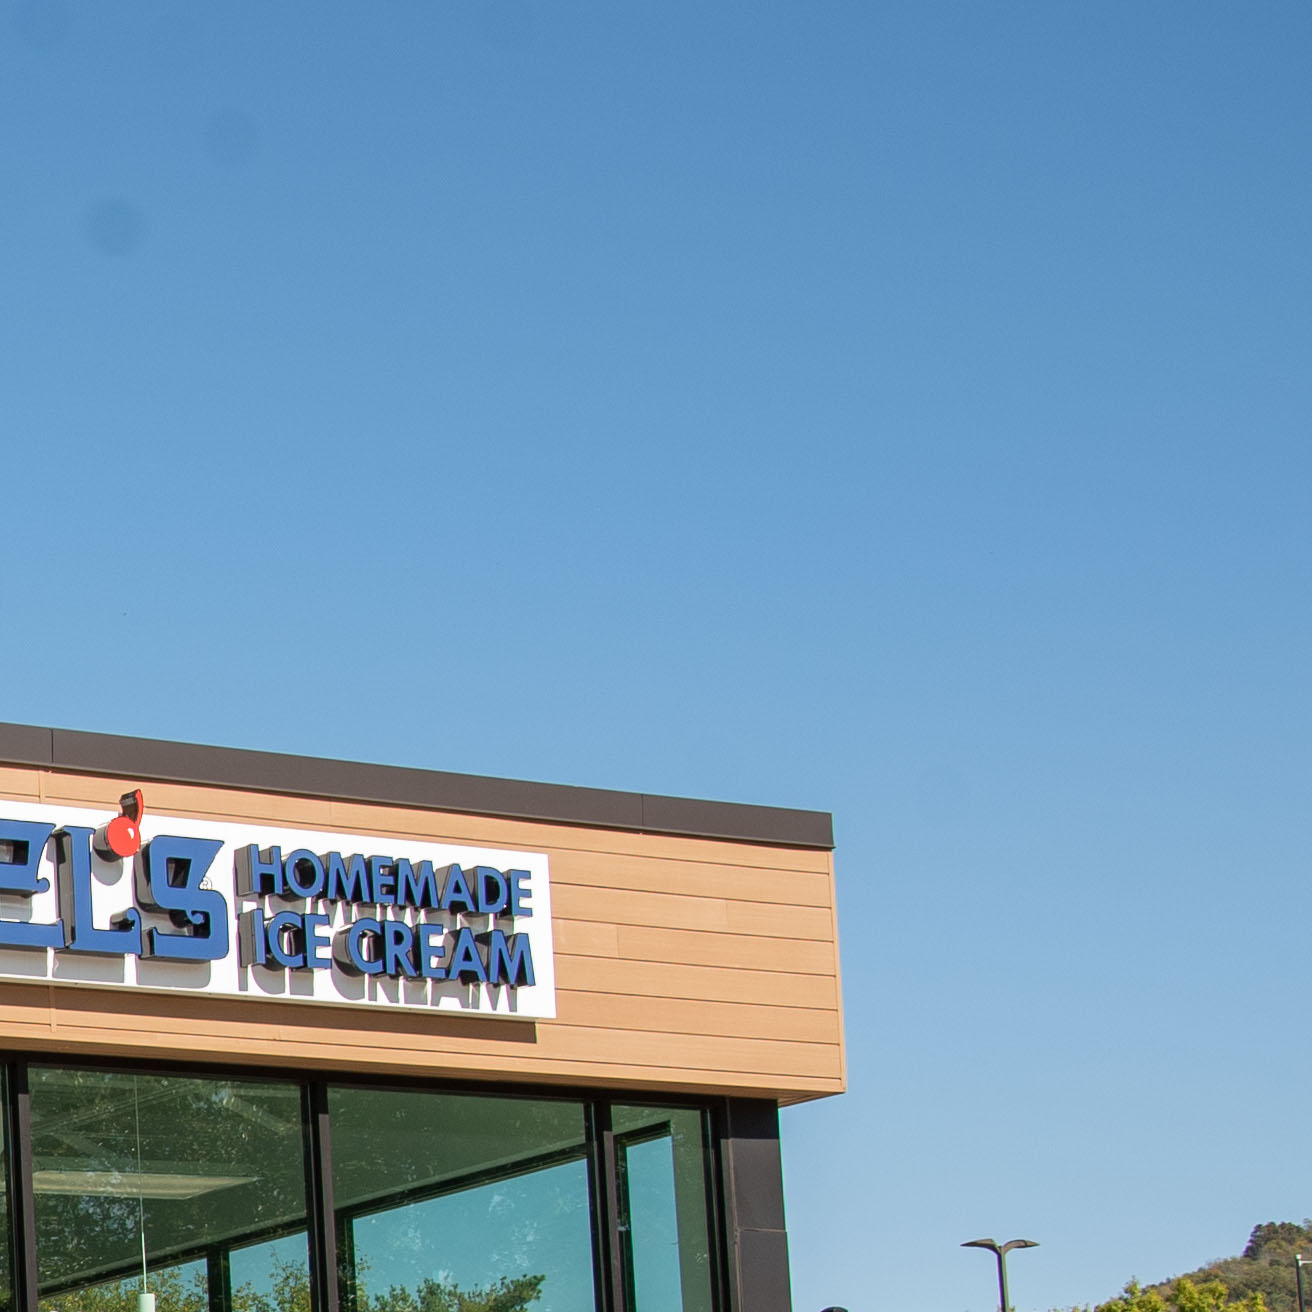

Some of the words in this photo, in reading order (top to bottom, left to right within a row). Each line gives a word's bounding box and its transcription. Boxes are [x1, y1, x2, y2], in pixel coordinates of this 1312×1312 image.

[244, 843, 534, 918] HOMEMADE
[244, 908, 333, 969] ICE
[342, 917, 537, 986] CREAM
